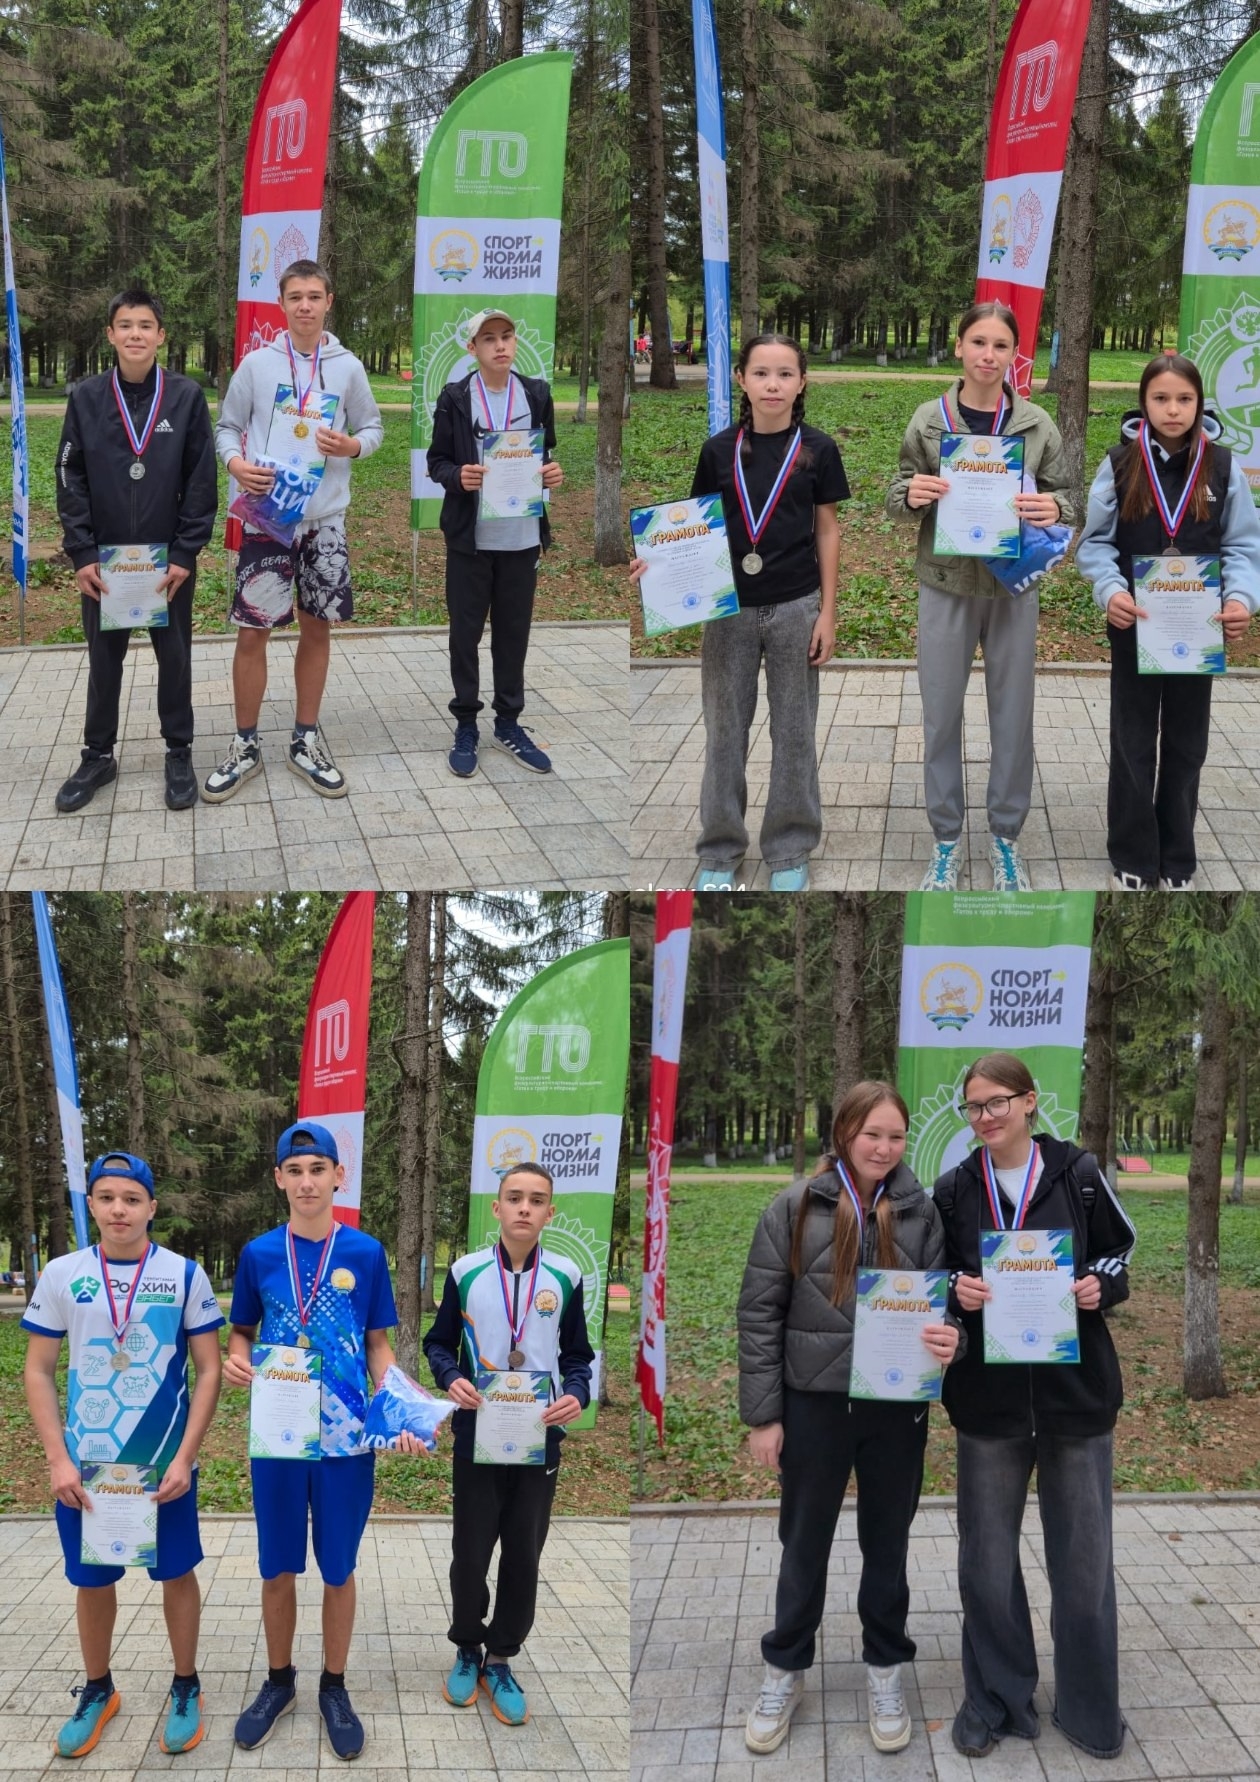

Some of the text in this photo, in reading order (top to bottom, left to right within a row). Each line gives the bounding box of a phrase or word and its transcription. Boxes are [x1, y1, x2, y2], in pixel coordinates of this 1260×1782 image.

[1009, 39, 1058, 120] ГТО
[262, 98, 307, 164] ГТО
[455, 129, 528, 178] ГТО
[484, 235, 532, 250] СПОРТ
[483, 250, 542, 265] НОРМА
[482, 265, 541, 280] ЖИЗНИ
[282, 405, 322, 421] ГРАОТА
[954, 460, 1008, 474] ГРАМОТА
[651, 523, 711, 545] ГРАМОТА
[261, 555, 290, 568] GEAR
[1149, 580, 1205, 592] ГРАМОТА
[991, 969, 1052, 988] СПОРТ
[990, 987, 1063, 1007] НОРМА
[988, 1007, 1062, 1027] ЖИЗНИ
[314, 999, 350, 1067] ГТО
[515, 1024, 591, 1073] ГТО
[542, 1132, 591, 1147] СПОРТ
[541, 1147, 600, 1163] НОРМА
[542, 1163, 599, 1178] ЖИЗНИ
[998, 1258, 1058, 1273] ГРАМОТА
[872, 1299, 931, 1313] ГРАМОТА
[265, 1369, 310, 1383] ГРАМОТА
[490, 1391, 536, 1403] ГРАМОТА
[96, 1483, 145, 1495] ГРАМОТА
